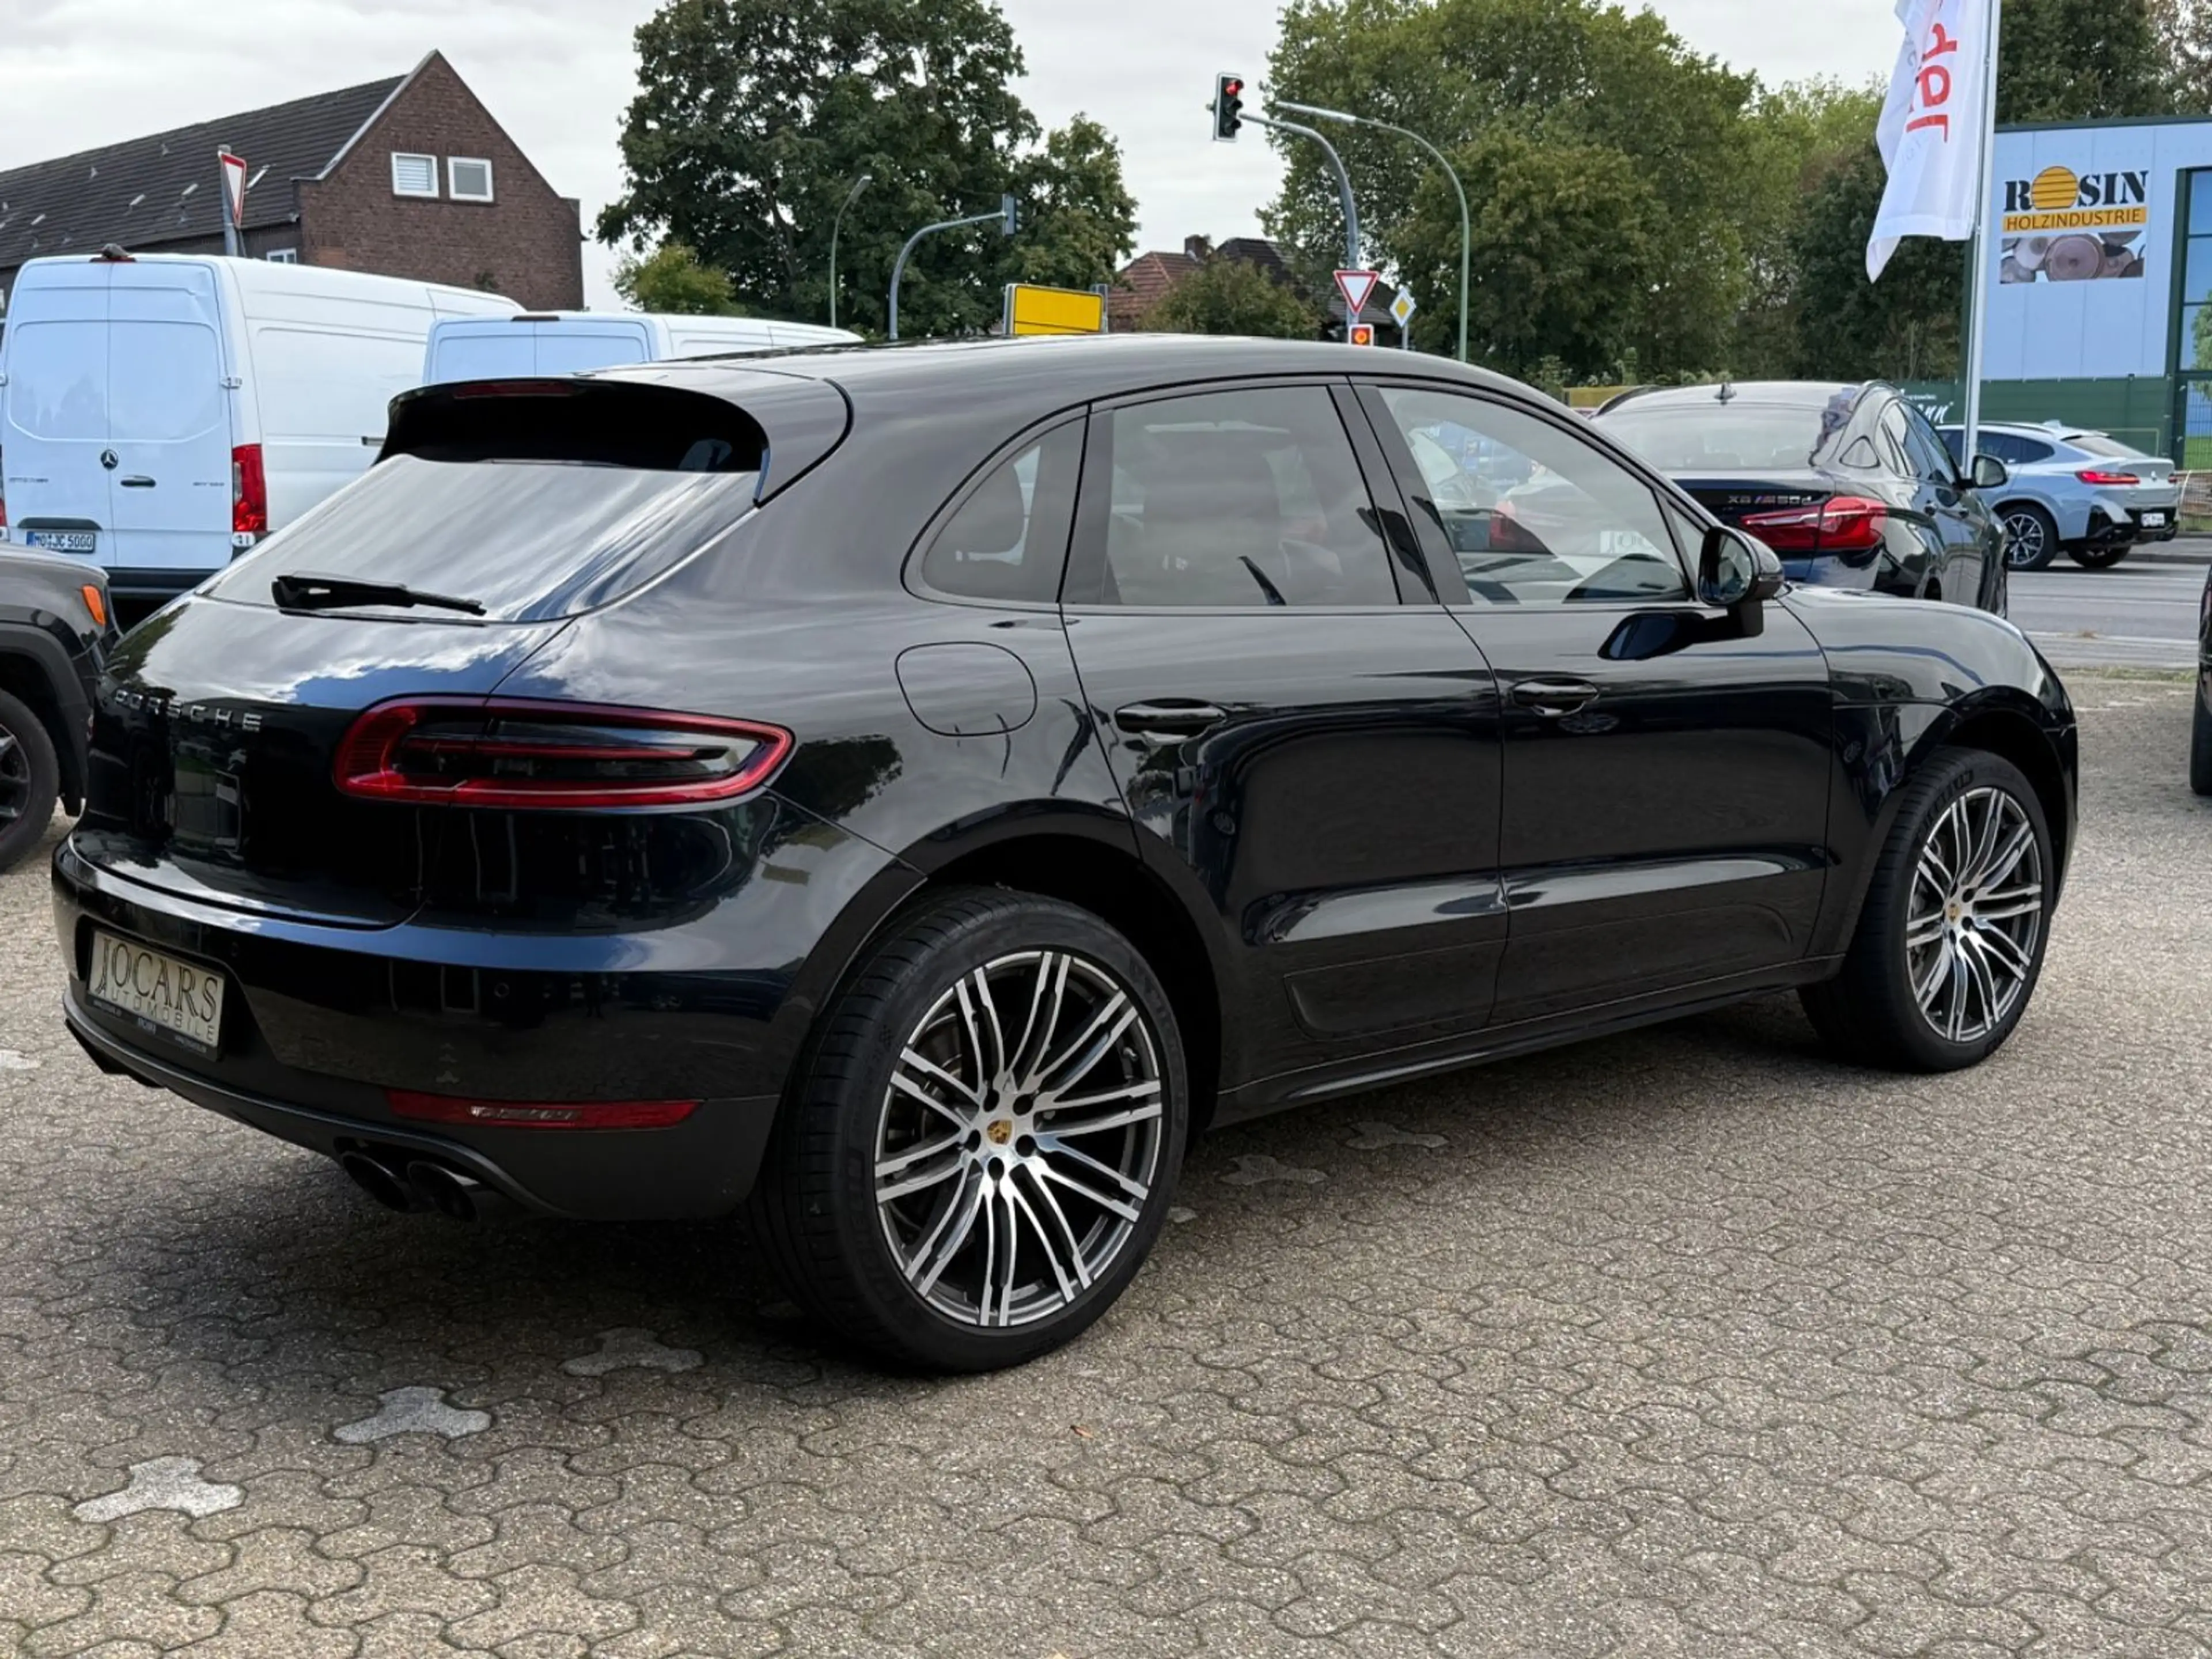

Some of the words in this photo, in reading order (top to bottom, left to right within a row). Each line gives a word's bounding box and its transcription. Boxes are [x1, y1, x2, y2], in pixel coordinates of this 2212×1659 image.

[2003, 166, 2150, 212] ROSIN
[2006, 208, 2141, 230] HOLZINDUSTRIE
[115, 690, 263, 732] PORSCHE
[94, 937, 218, 1022] JOCARS
[96, 983, 215, 1041] AUTOMOBILE
